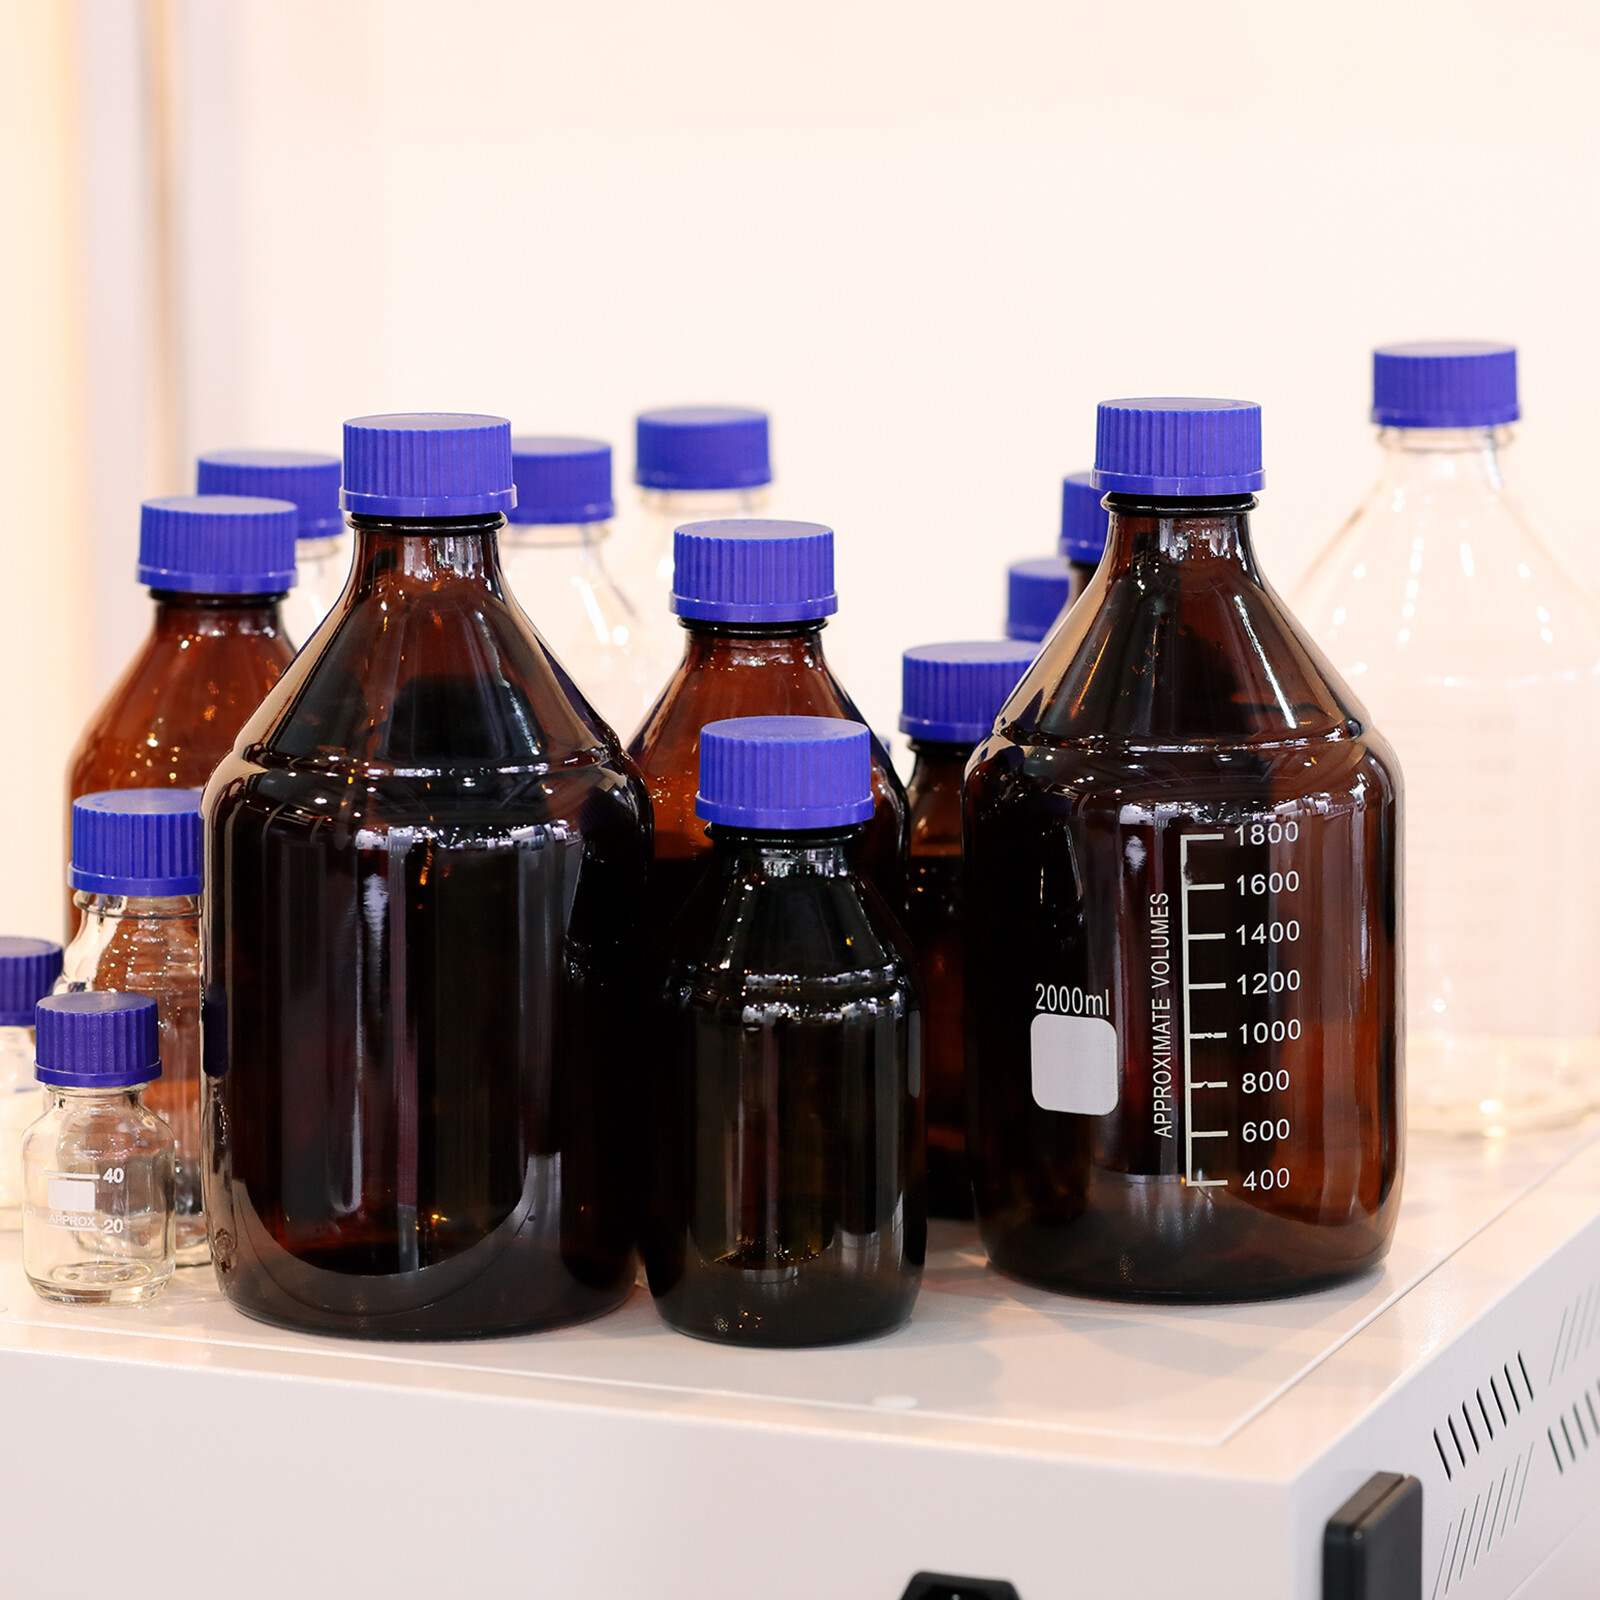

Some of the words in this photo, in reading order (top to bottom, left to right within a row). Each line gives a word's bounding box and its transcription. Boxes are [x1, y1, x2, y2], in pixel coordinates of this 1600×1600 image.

[1234, 821, 1299, 846] 1800
[1236, 871, 1300, 896] 1600
[1150, 892, 1170, 989] VOLUMES
[1236, 920, 1300, 946] 1400
[1236, 969, 1300, 995] 1200
[1035, 983, 1110, 1016] 2000ml
[1238, 1019, 1302, 1045] 1000
[1151, 998, 1173, 1138] APPROXIMATE
[1242, 1069, 1290, 1094] 800
[1242, 1118, 1290, 1143] 600
[103, 1167, 124, 1184] 40
[1243, 1168, 1290, 1192] 400
[49, 1214, 96, 1227] APPROX
[103, 1218, 124, 1234] 20
